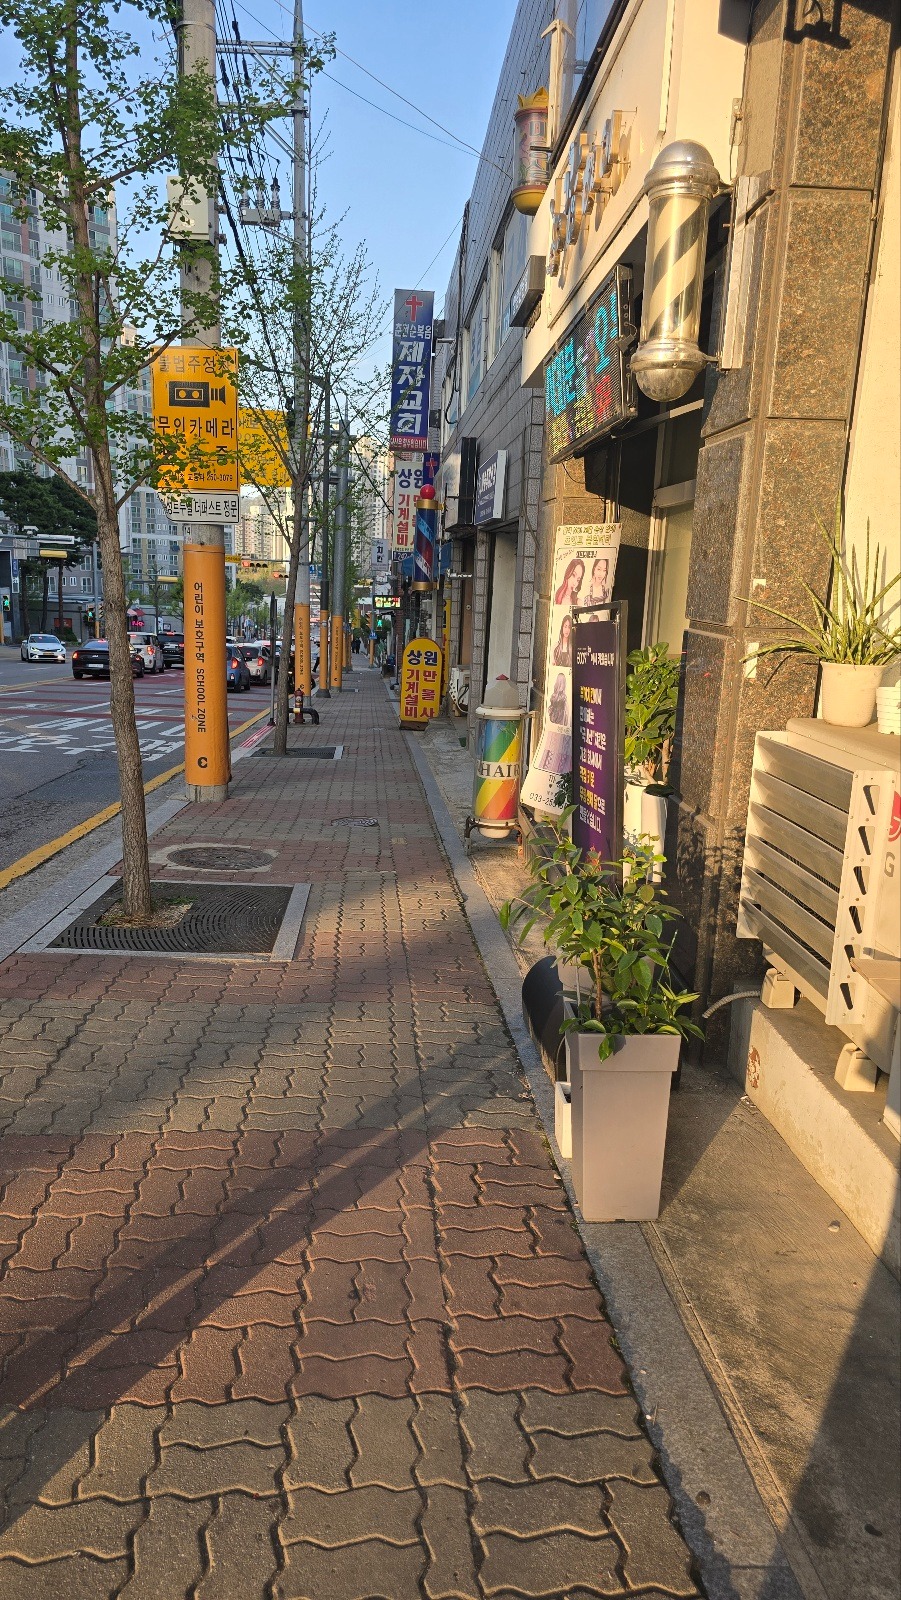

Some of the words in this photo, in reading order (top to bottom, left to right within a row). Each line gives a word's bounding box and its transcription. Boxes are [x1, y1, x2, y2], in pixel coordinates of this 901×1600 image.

[396, 340, 426, 435] 제자교회
[158, 416, 234, 438] 무인카메라
[396, 494, 411, 547] 기계설비
[194, 582, 204, 616] 어린이
[194, 619, 205, 663] 보호구역
[406, 650, 438, 667] 상원
[196, 668, 205, 706] SCHOOL
[404, 669, 421, 719] 기계설비
[197, 708, 206, 733] ZONE
[480, 763, 520, 778] HAIR
